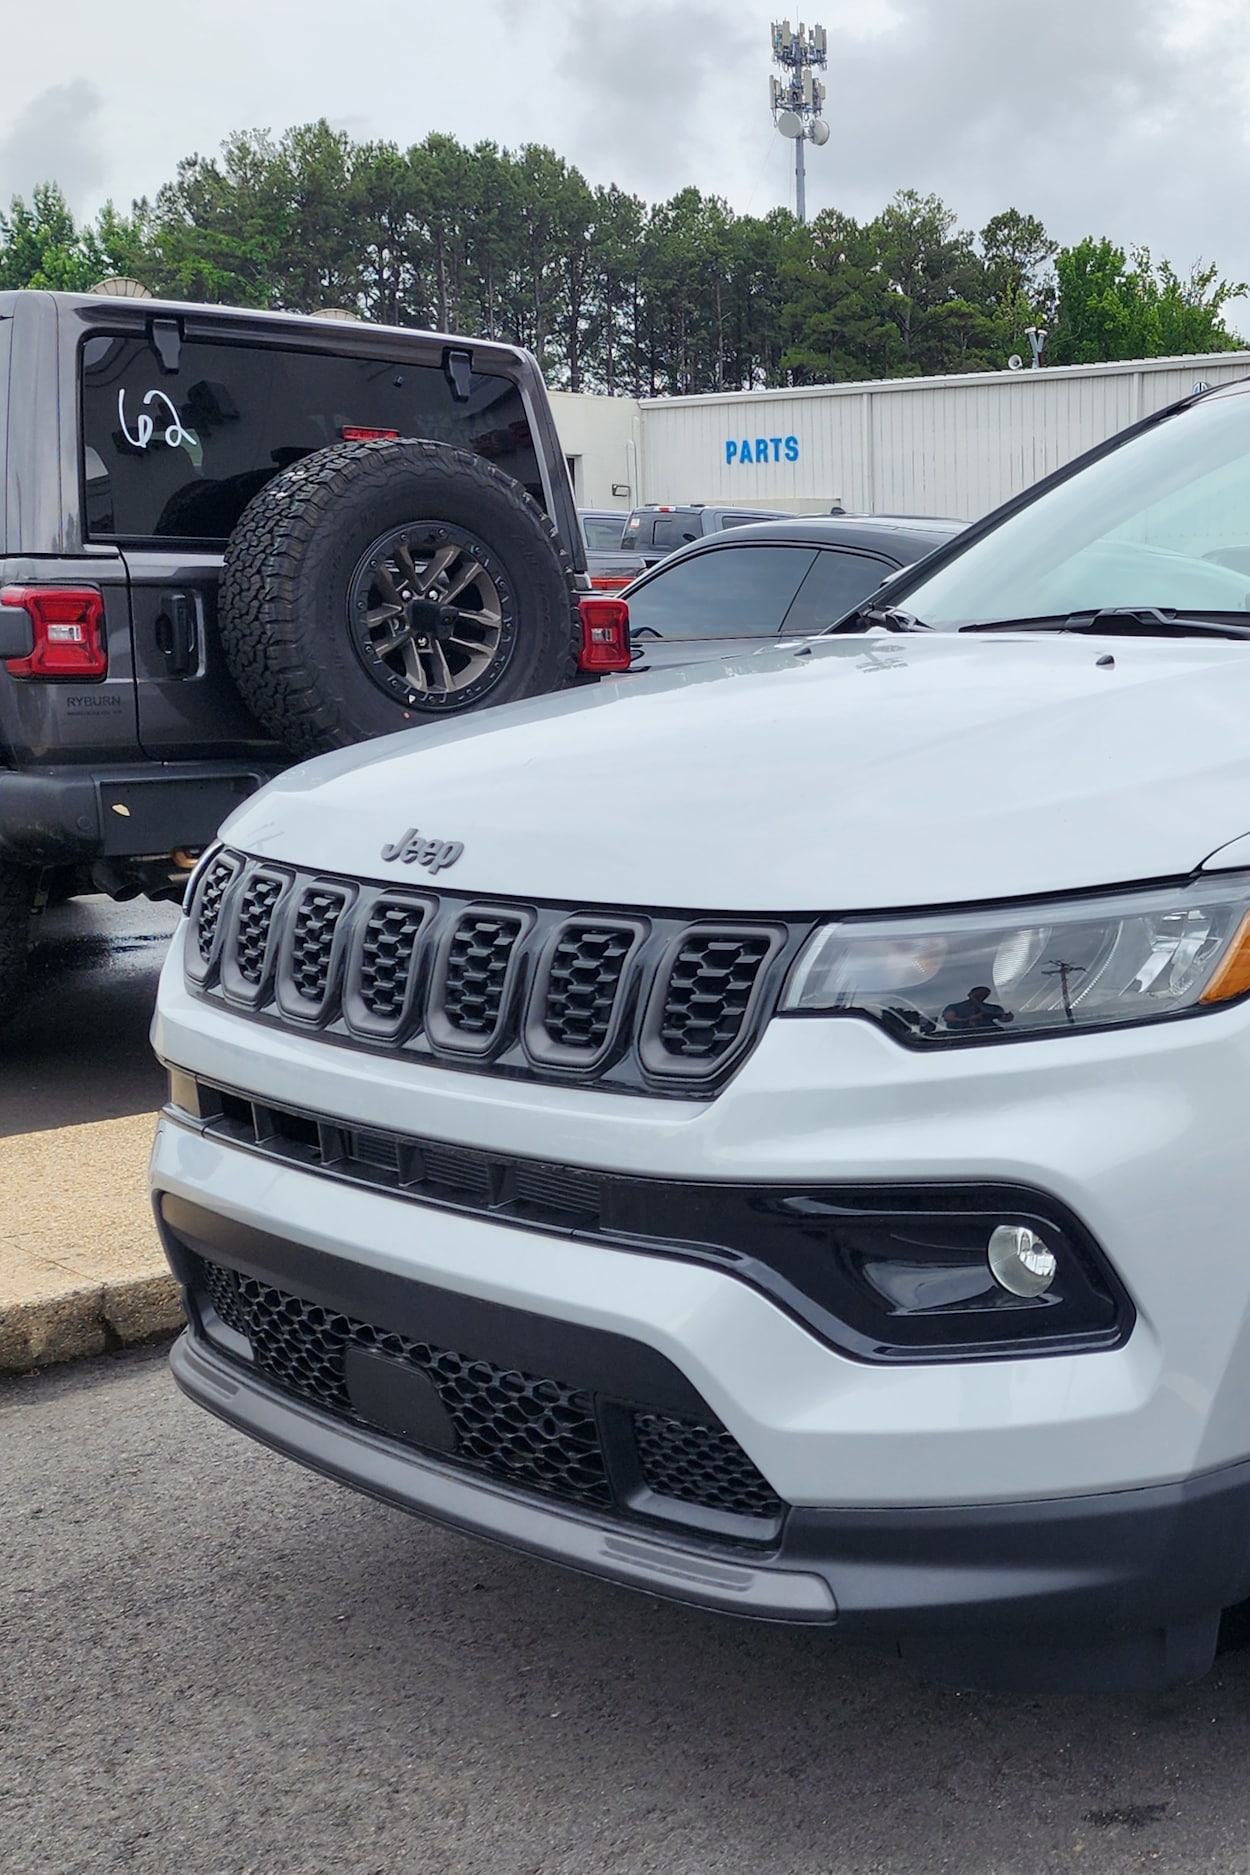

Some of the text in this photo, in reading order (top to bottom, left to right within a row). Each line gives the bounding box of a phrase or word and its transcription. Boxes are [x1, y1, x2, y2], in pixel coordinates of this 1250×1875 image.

[118, 388, 197, 449] 62
[726, 436, 799, 465] PARTS
[66, 695, 121, 707] RYBURN
[380, 828, 464, 875] Jeep
